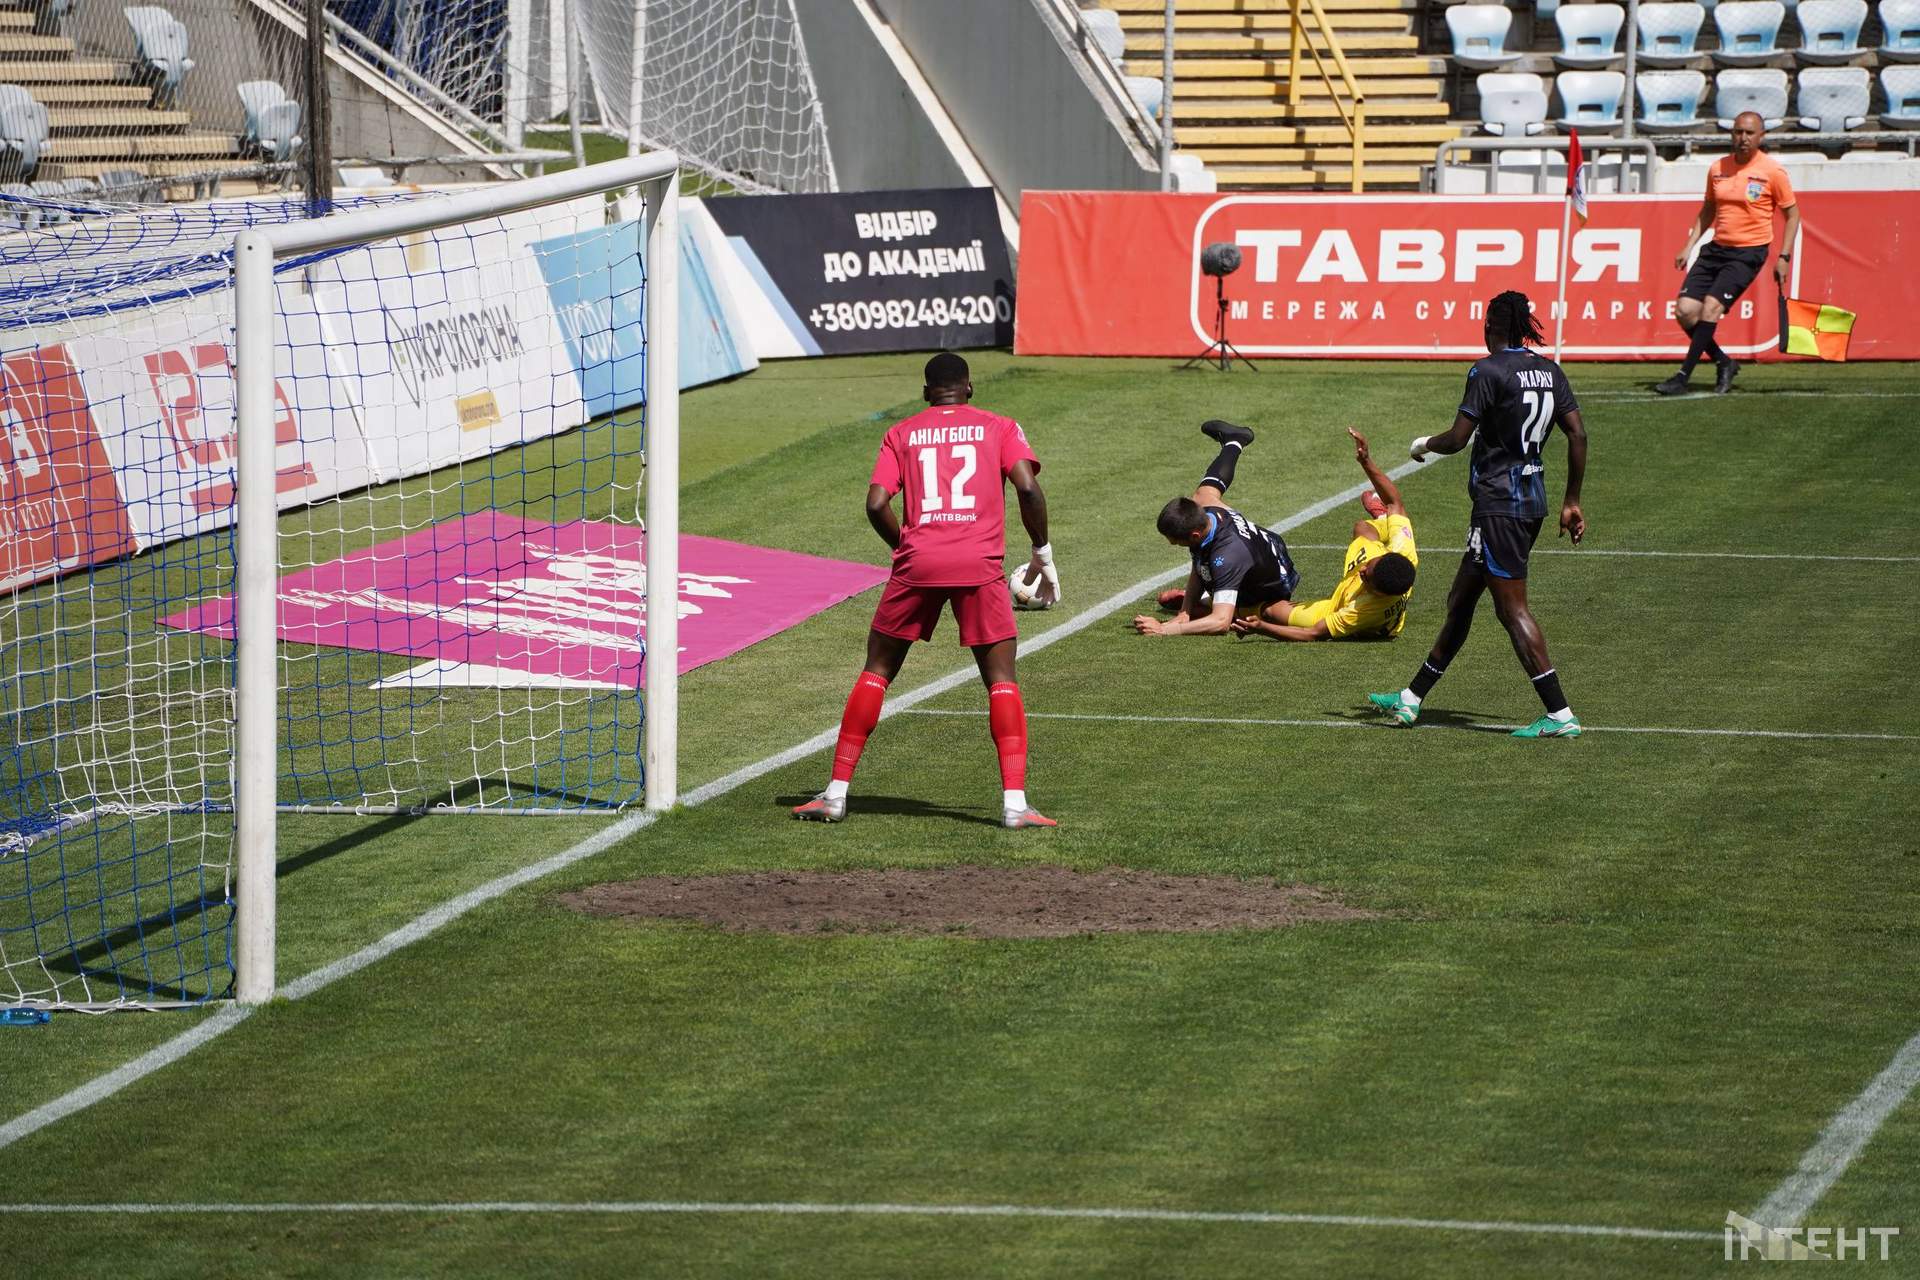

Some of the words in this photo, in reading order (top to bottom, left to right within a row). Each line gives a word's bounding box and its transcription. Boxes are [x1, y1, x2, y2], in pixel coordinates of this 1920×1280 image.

[855, 210, 938, 242] ВІДБІР
[823, 252, 862, 283] ДО
[868, 240, 986, 278] АКАДЕМІЇ
[1234, 229, 1642, 283] ТАВРІЯ
[809, 295, 1011, 332] +380982484200
[1231, 301, 1386, 320] МЕРЕЖА
[403, 303, 526, 382] УКРОХОРОНА
[908, 425, 985, 447] АНІАГБОСО
[1521, 390, 1555, 455] 24
[918, 444, 977, 513] 12
[932, 513, 953, 522] MTB
[955, 513, 977, 522] Bank
